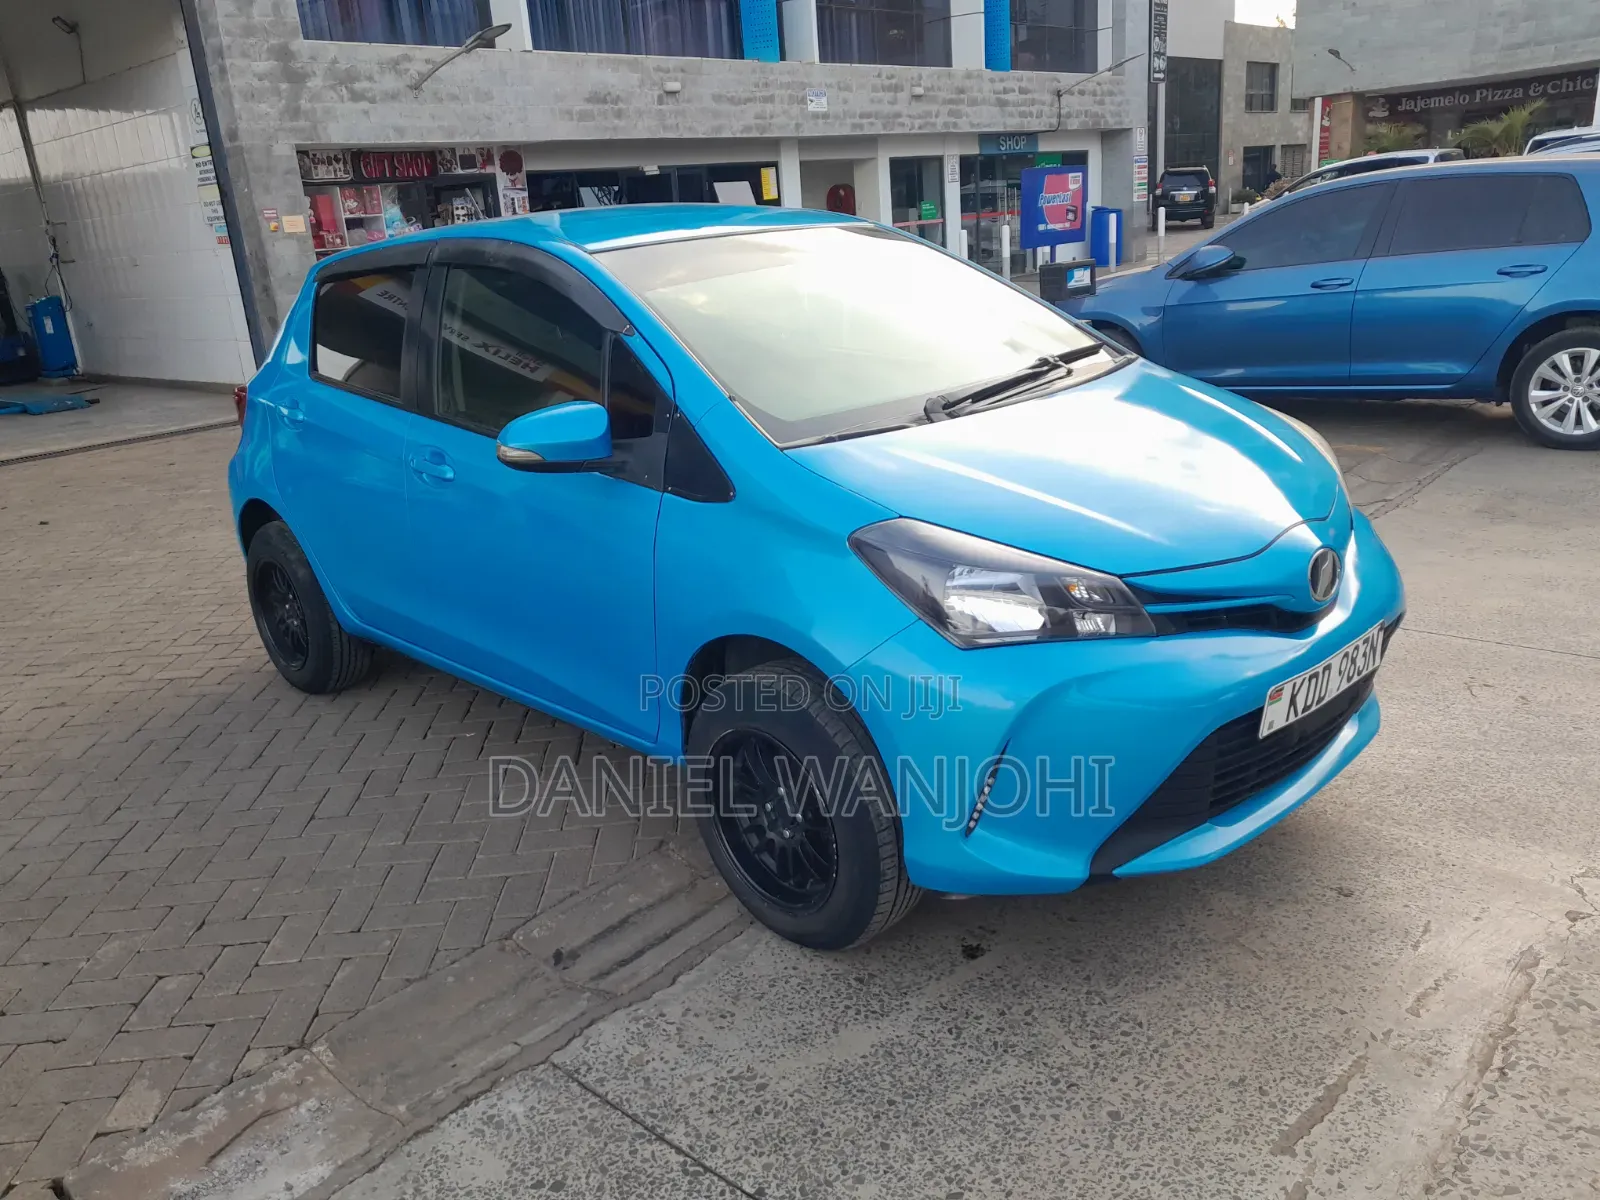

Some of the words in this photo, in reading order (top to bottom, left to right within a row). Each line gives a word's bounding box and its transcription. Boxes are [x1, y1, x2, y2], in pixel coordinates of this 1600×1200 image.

[1398, 91, 1470, 112] Jajemelo
[1475, 87, 1523, 103] Pizza
[1529, 82, 1544, 97] &
[999, 135, 1027, 152] SHOP
[361, 152, 391, 178] GIFT
[394, 152, 431, 178] SHOP
[1286, 662, 1333, 723] KDD
[1337, 627, 1381, 692] 983N
